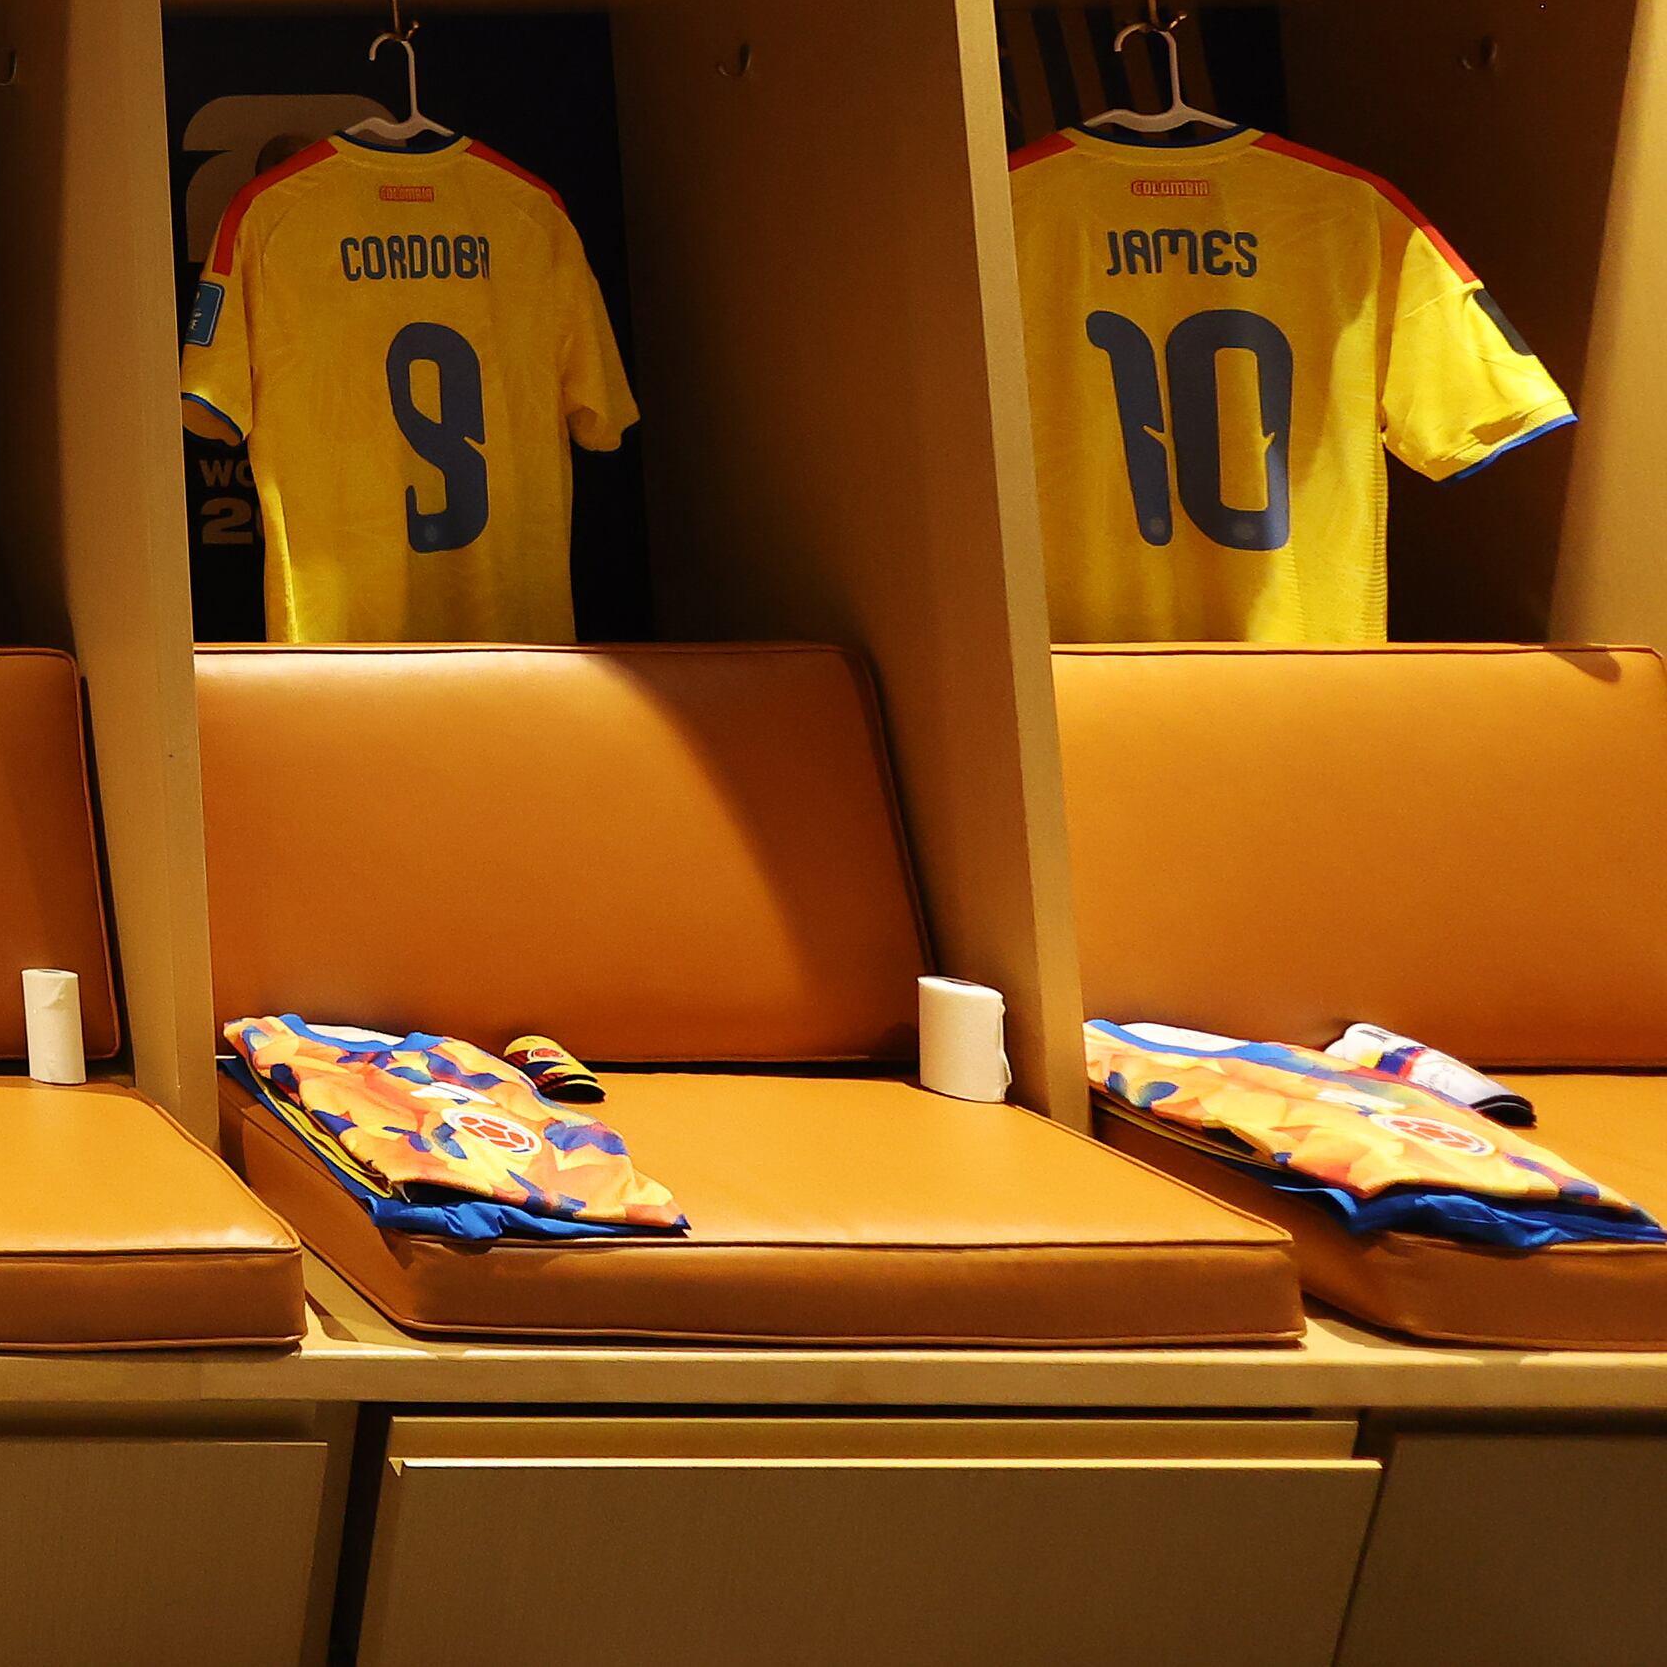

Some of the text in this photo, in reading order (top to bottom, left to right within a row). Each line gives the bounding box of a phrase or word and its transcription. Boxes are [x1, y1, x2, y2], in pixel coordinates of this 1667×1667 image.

[1106, 228, 1258, 278] JAMES
[1131, 179, 1211, 197] COLOMBIA
[385, 321, 489, 554] 9
[1085, 308, 1294, 551] 10
